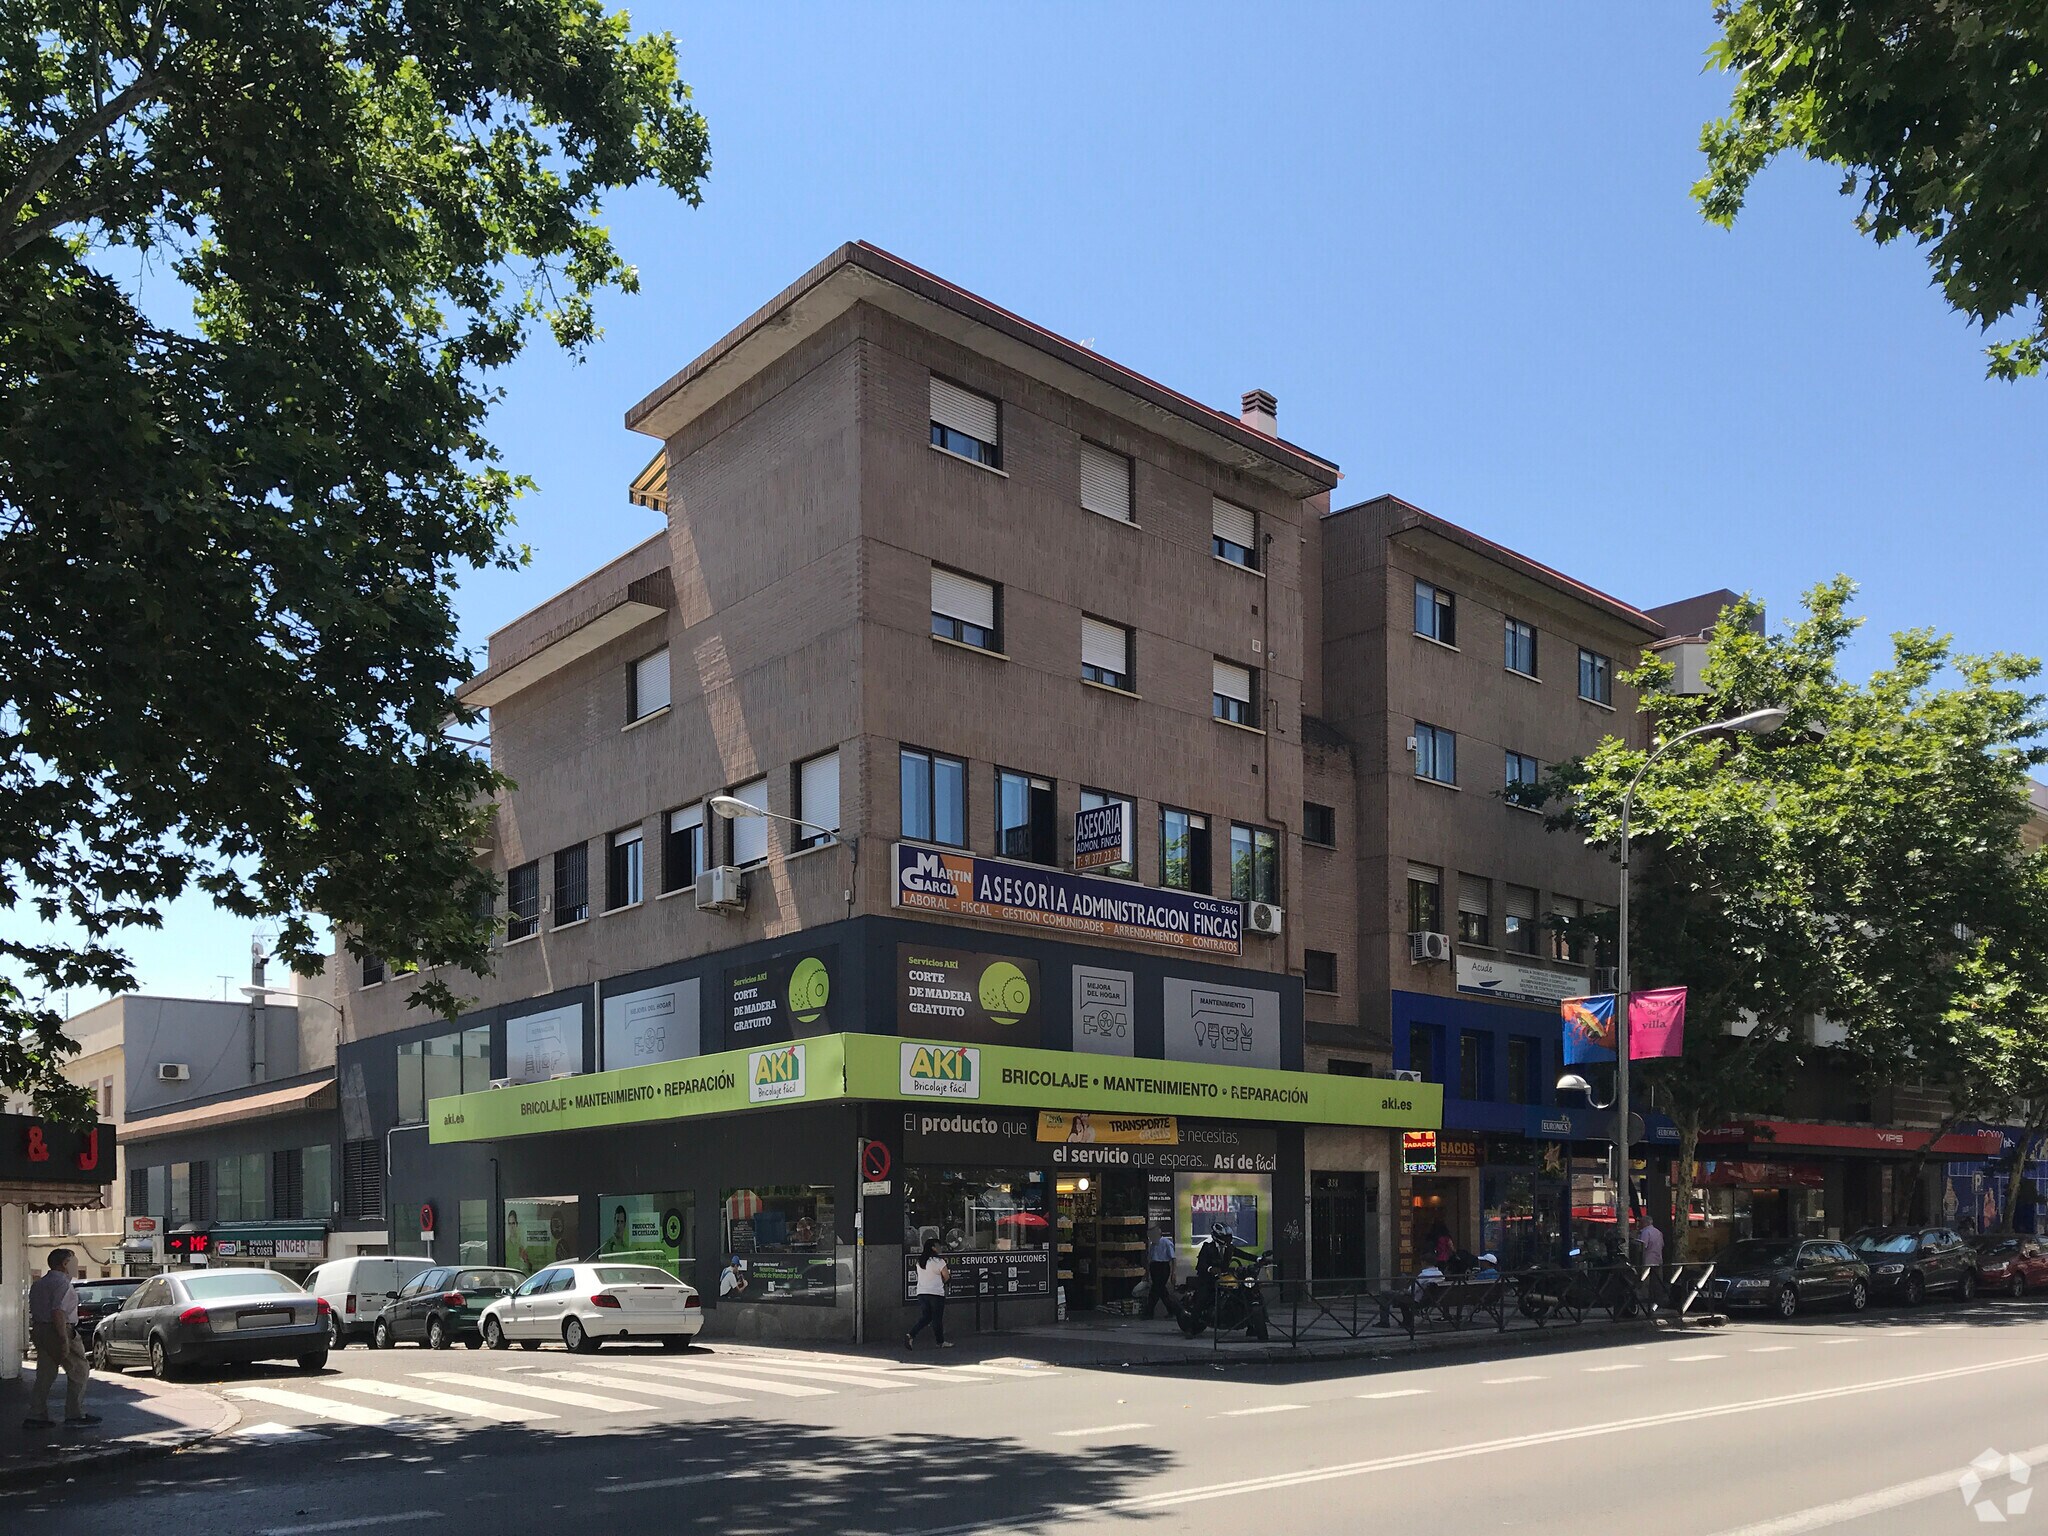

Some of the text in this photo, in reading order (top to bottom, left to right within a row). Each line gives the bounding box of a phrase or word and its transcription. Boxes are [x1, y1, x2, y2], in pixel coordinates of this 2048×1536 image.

[1077, 807, 1121, 841] ASESORIA
[1076, 834, 1121, 853] ADMON. FINCAS
[1084, 855, 1090, 865] 91
[1092, 852, 1102, 864] 377
[1104, 850, 1111, 861] 23
[1114, 849, 1120, 860] 26
[917, 852, 972, 884] MARTIN
[901, 866, 959, 897] GARCIA
[980, 874, 1238, 940] ASESORIA ADMINISTRACION FINCAS
[1193, 900, 1239, 916] COLG. 5566
[903, 892, 1238, 952] LABORAL FISCAL GESTION COMUNIDADES ARRENDAMIENTOS CONTRATOS
[908, 956, 943, 967] Servicios
[1471, 962, 1493, 973] Acude
[733, 975, 757, 987] Servicios
[908, 970, 945, 984] CORTE
[1087, 982, 1111, 991] MEJORA
[734, 988, 758, 1001] CORTE
[908, 986, 972, 1002] DE MADERA
[1099, 991, 1120, 999] HOGAR
[656, 1001, 672, 1010] HOGAR
[734, 999, 777, 1017] DE MADERA
[908, 1003, 965, 1017] GRATUITO
[1200, 997, 1246, 1009] MANTENIMIENTO
[734, 1016, 771, 1031] GRATUITO
[1642, 1020, 1666, 1029] villa
[521, 1069, 735, 1116] BRICOLAJE MANTENIMIENTO REPARACIÓN
[758, 1082, 796, 1099] Bricolaje fácil
[914, 1080, 967, 1095] Bricolaje fácil
[1002, 1068, 1308, 1104] BRICOLAJE MANTENIMIENTO REPARACIÓN
[1381, 1097, 1412, 1110] aki.es
[444, 1113, 465, 1126] aki.es
[1109, 1117, 1170, 1132] TRANSPORTE
[1543, 1122, 1569, 1131] EURONICS
[903, 1113, 916, 1131] El
[921, 1114, 998, 1135] producto
[1002, 1121, 1027, 1138] que
[1188, 1128, 1241, 1145] necesitas,
[1139, 1129, 1170, 1140] GRATIS
[1699, 1127, 1745, 1136] VIPS
[1877, 1133, 1904, 1143] VIPS
[1441, 1141, 1475, 1155] BACOS
[1053, 1146, 1277, 1170] el servicio que esperas... Así de fácil
[1148, 1174, 1171, 1183] Horario
[249, 1247, 273, 1256] DE COSER
[276, 1240, 306, 1253] SINGER
[951, 1257, 960, 1265] DE
[961, 1256, 998, 1265] SERVICIOS
[999, 1256, 1003, 1264] Y
[1005, 1254, 1047, 1263] SOLUCIONES
